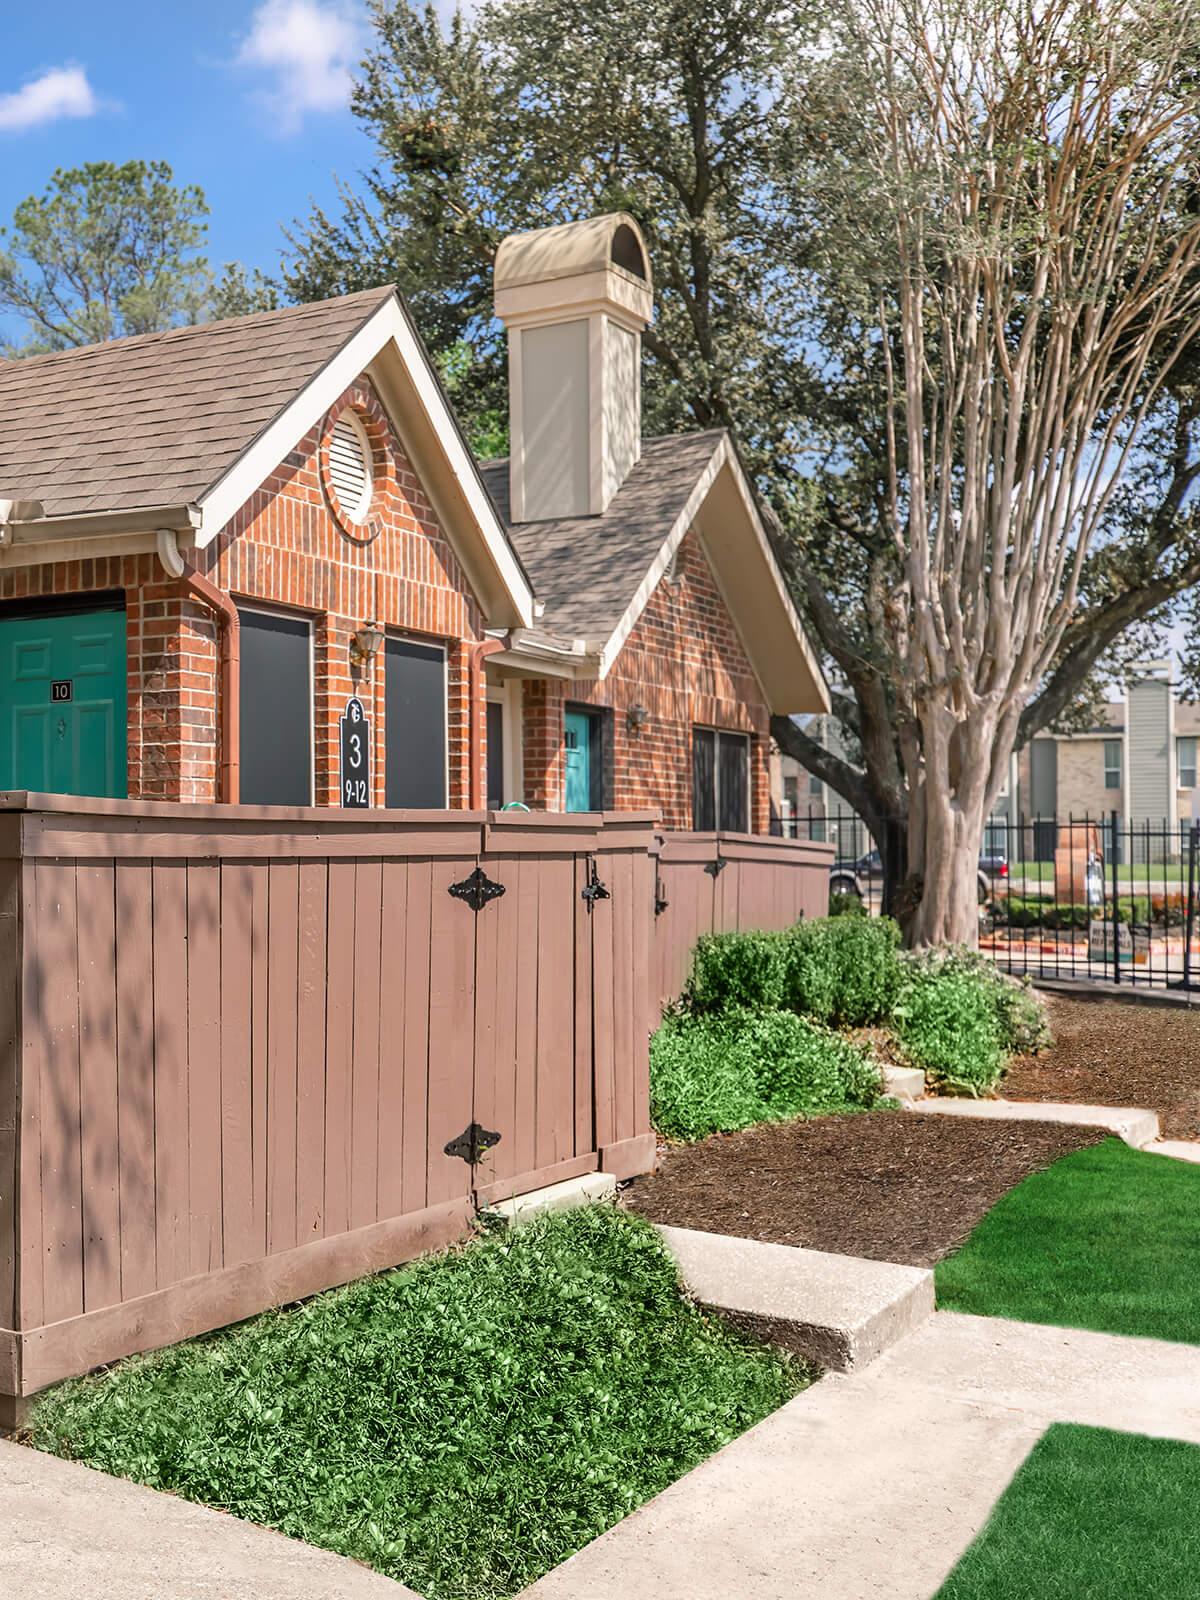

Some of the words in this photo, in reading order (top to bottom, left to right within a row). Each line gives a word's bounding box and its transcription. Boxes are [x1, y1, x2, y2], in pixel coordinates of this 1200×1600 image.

[55, 685, 68, 698] 10
[350, 734, 361, 768] 3
[345, 780, 367, 803] 9-12
